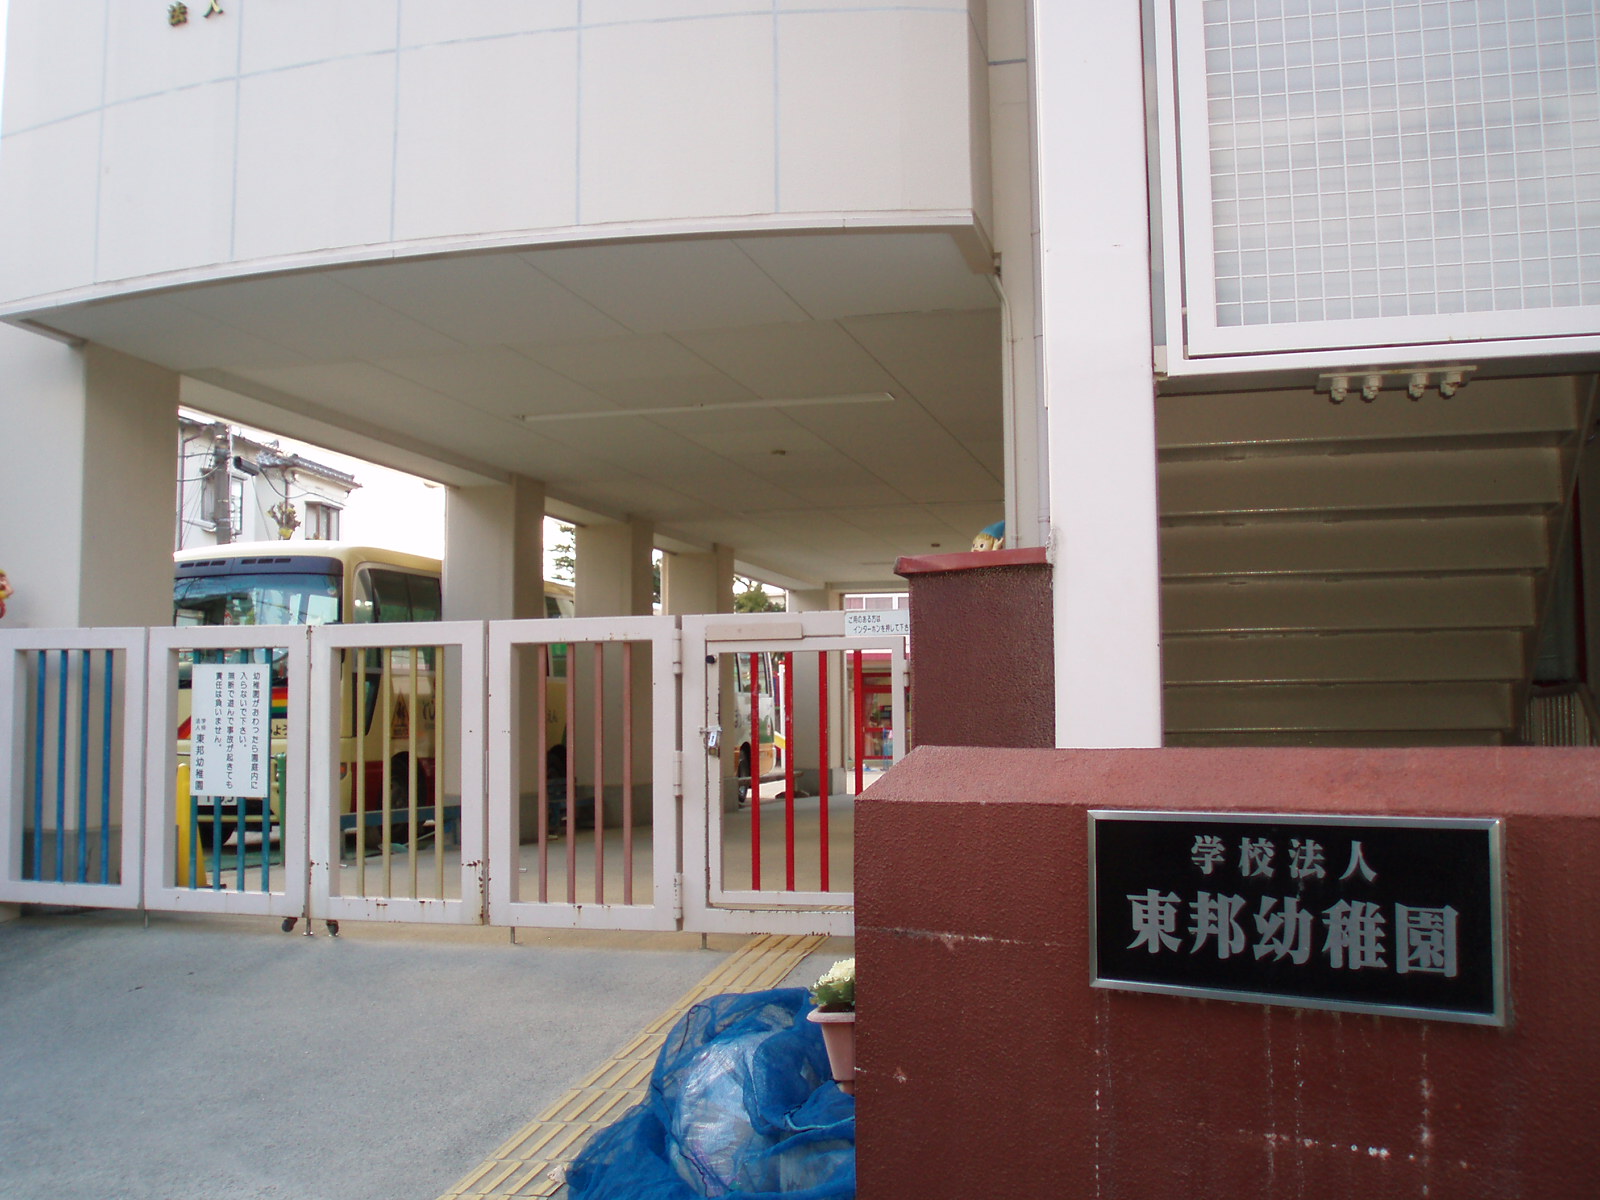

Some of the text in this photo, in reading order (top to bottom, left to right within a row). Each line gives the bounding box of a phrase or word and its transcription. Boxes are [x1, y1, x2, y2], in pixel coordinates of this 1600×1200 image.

[214, 672, 223, 747] 責任は負いません。
[226, 672, 235, 789] 無断で遊んで事故が起きても
[238, 672, 248, 748] 入らないで下さい。
[251, 672, 261, 790] 幼稚園がおわったら園庭内に
[195, 733, 205, 791] 東邦幼稚園
[1191, 834, 1378, 882] 学校法人
[1126, 888, 1460, 978] 東邦幼稚園
